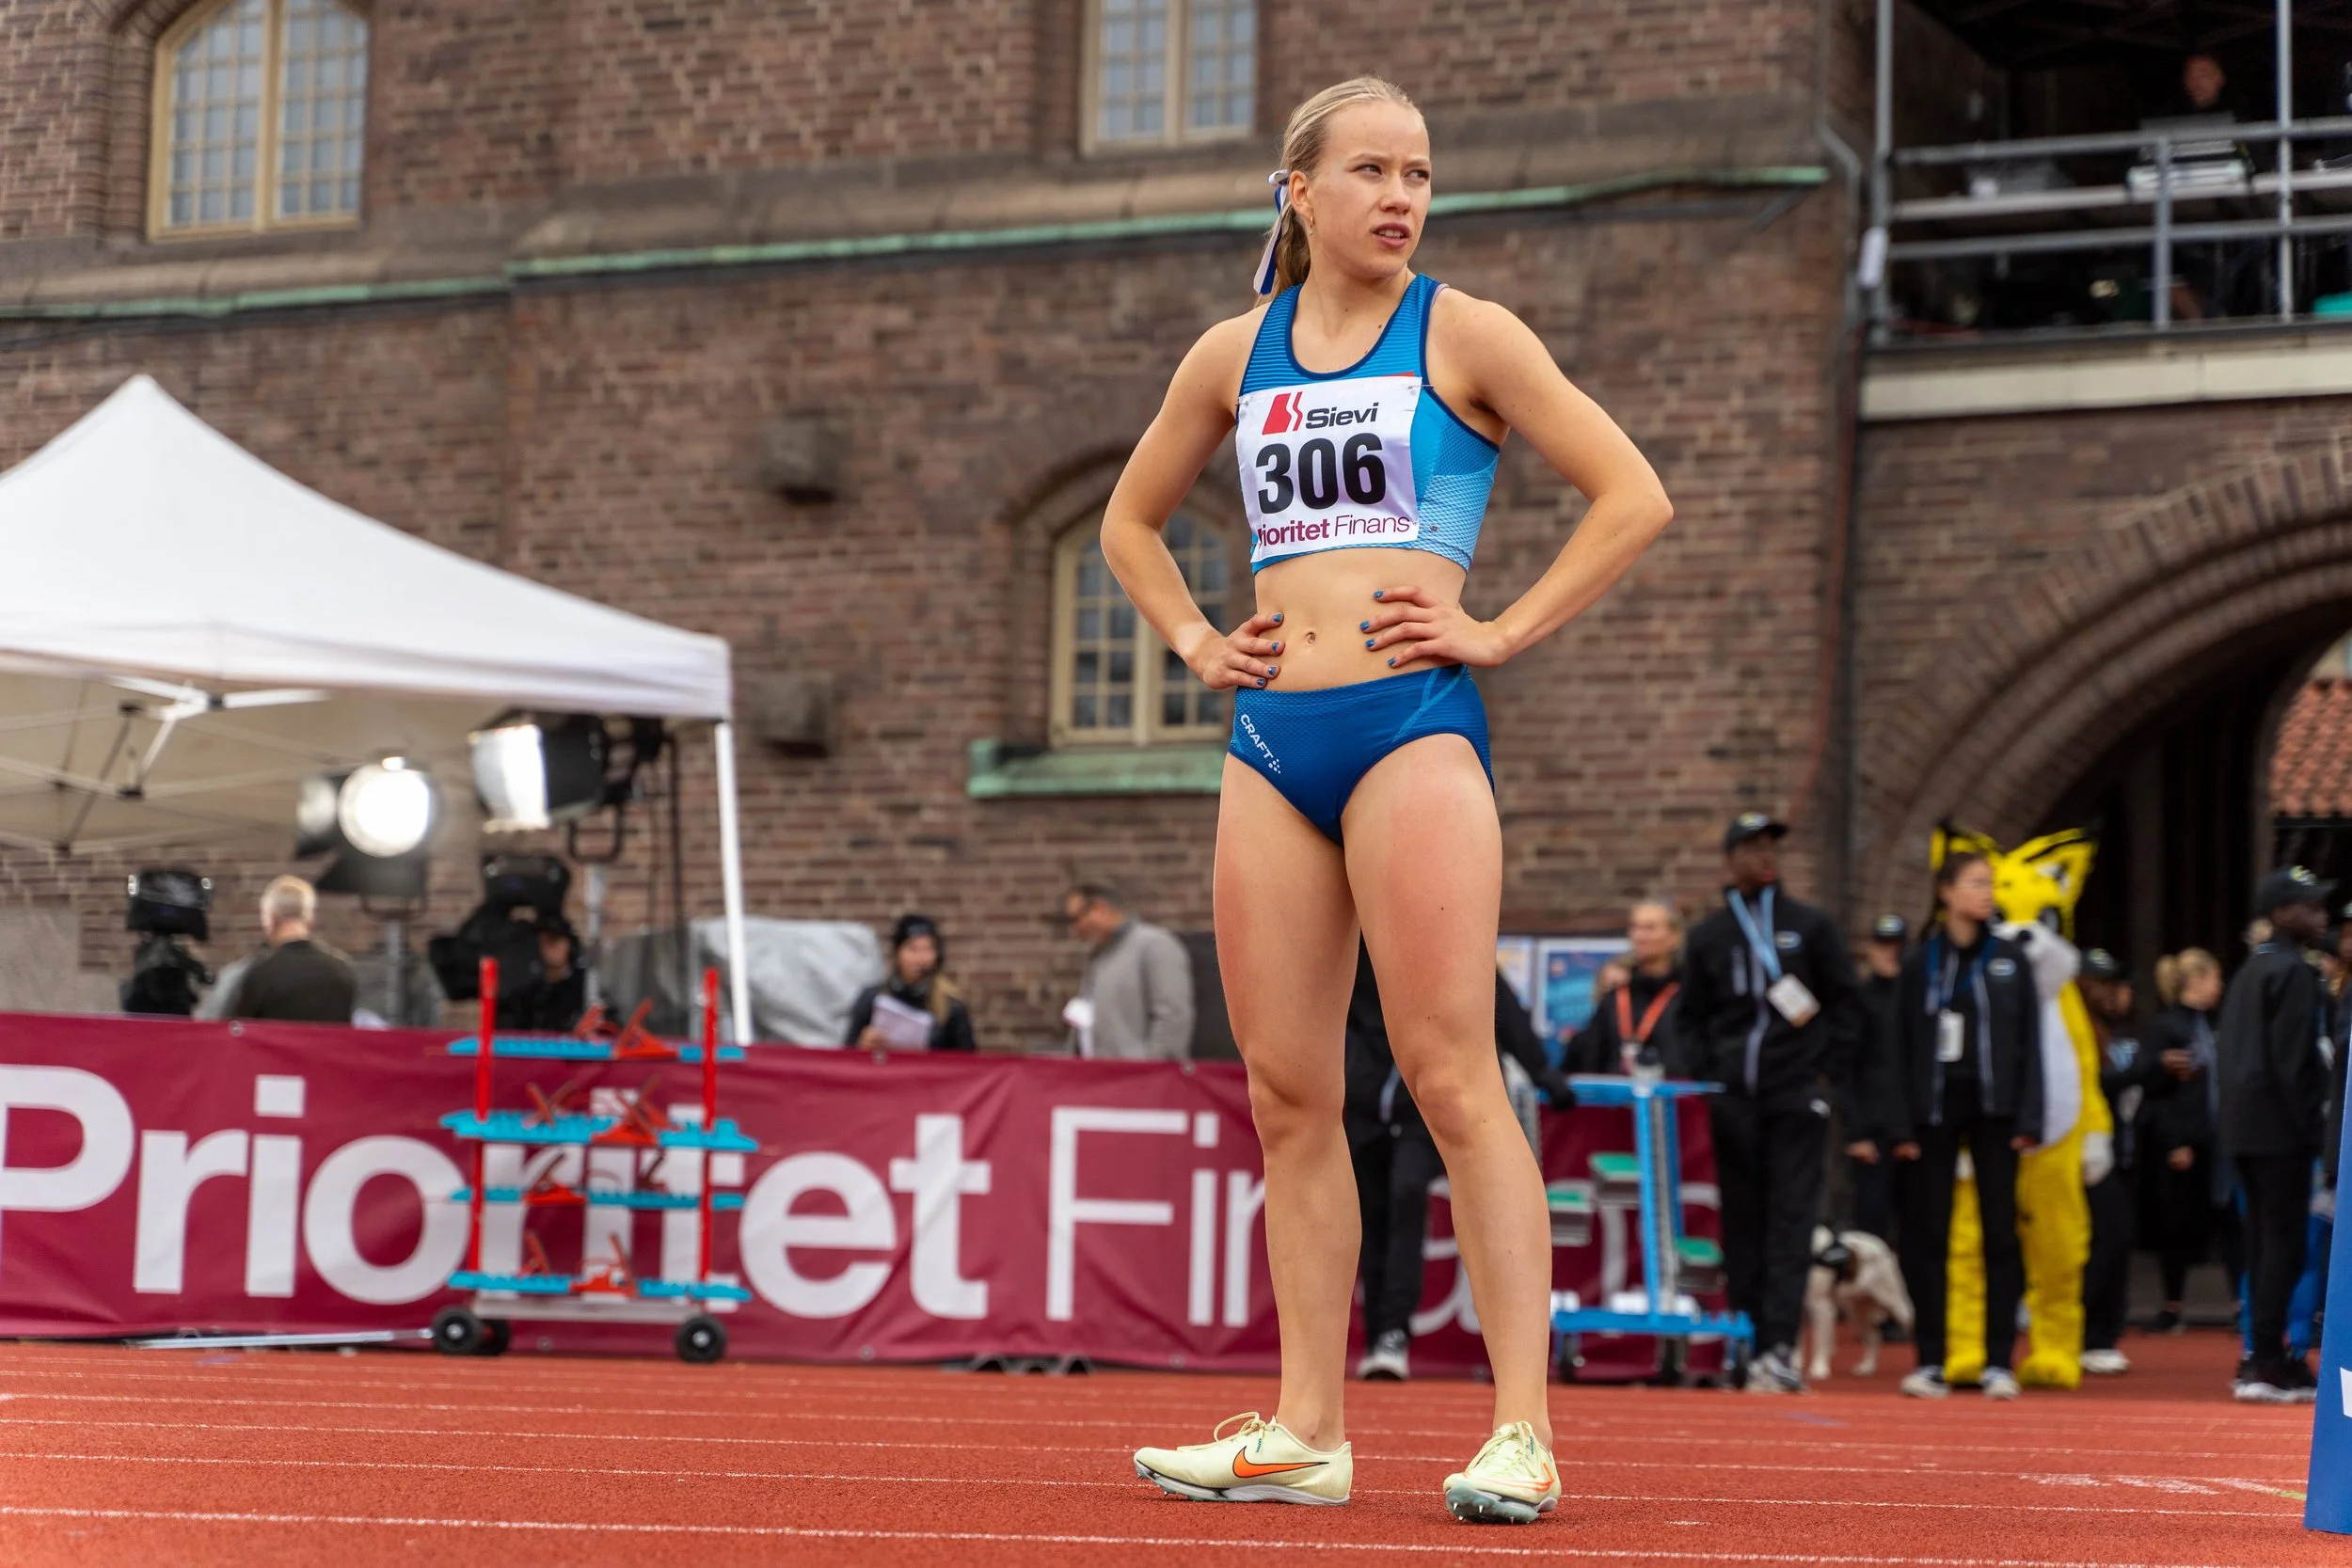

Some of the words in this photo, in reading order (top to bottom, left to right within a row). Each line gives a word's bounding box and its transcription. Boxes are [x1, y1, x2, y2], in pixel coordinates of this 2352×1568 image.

[1305, 402, 1379, 430] Sievi
[1255, 432, 1387, 515] 306
[1334, 514, 1410, 537] Finans
[1240, 714, 1275, 759] CRAFT
[0, 1063, 992, 1319] Prioritet
